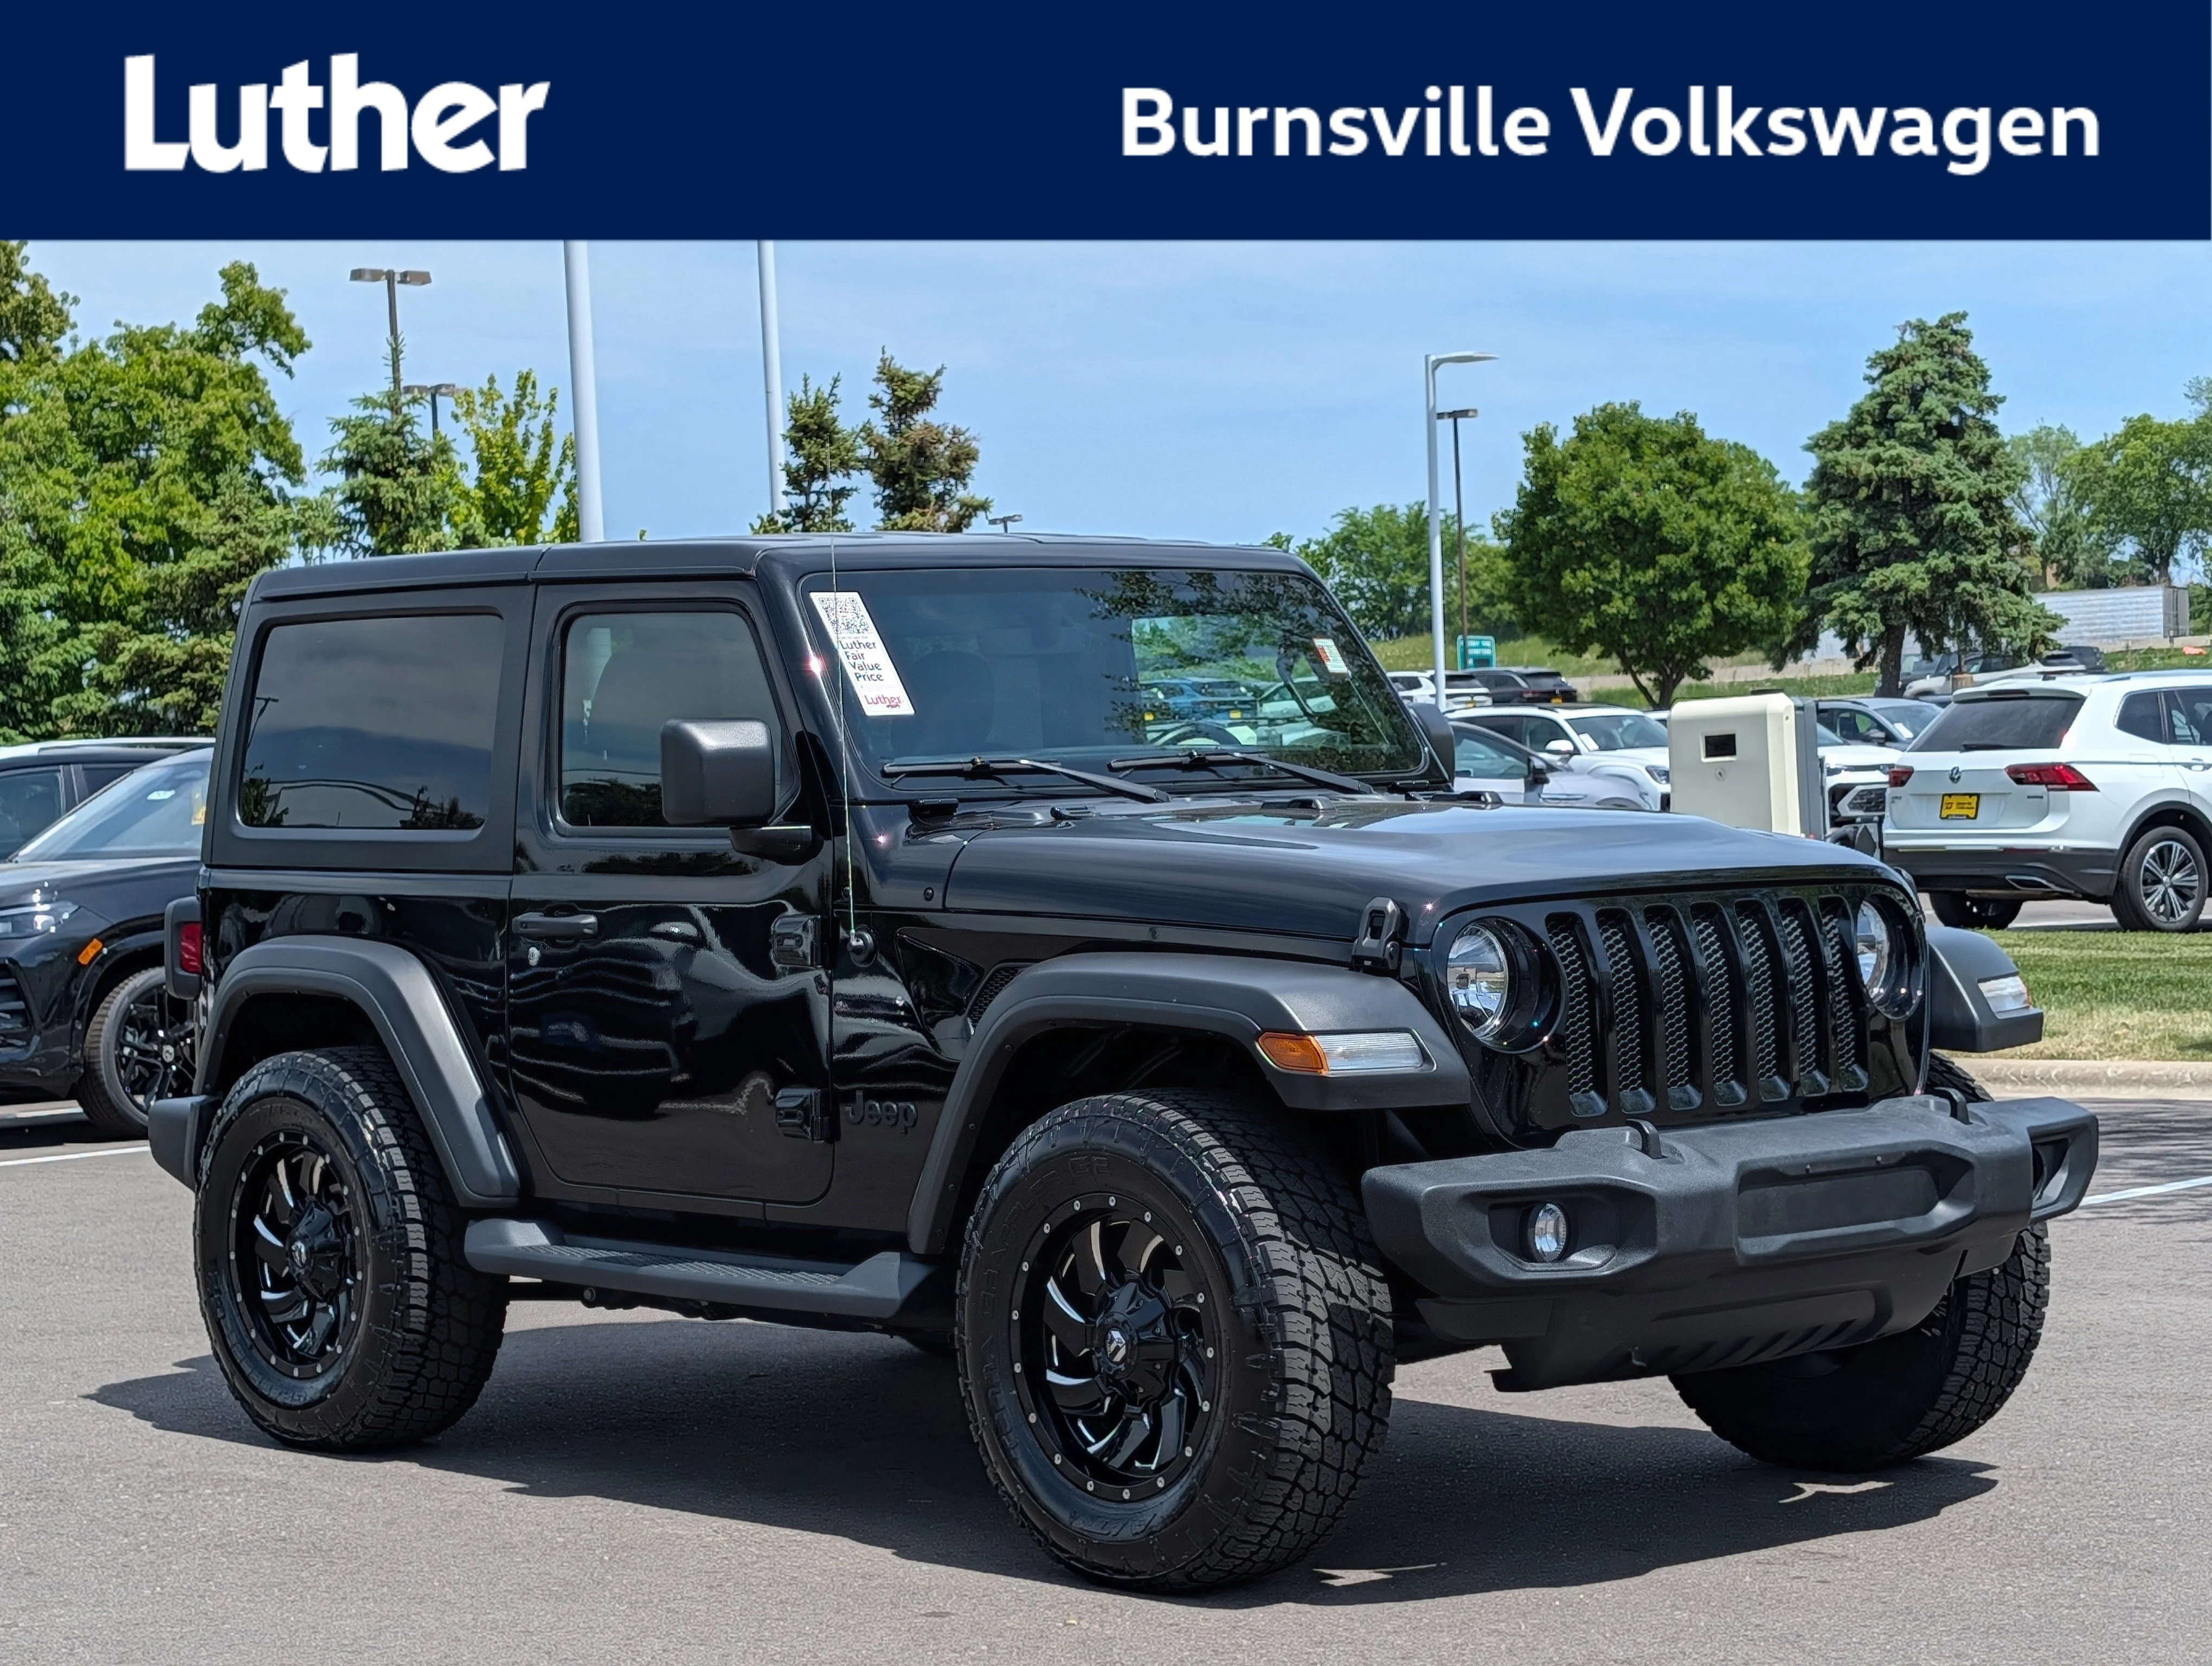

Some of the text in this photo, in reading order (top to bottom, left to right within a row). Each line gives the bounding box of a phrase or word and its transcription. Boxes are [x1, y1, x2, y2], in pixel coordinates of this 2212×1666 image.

[839, 639, 877, 649] Luther
[845, 650, 865, 660] Fair
[848, 661, 882, 671] Value
[854, 672, 884, 682] Price
[864, 694, 901, 704] Luther
[845, 1090, 918, 1135] Jeep
